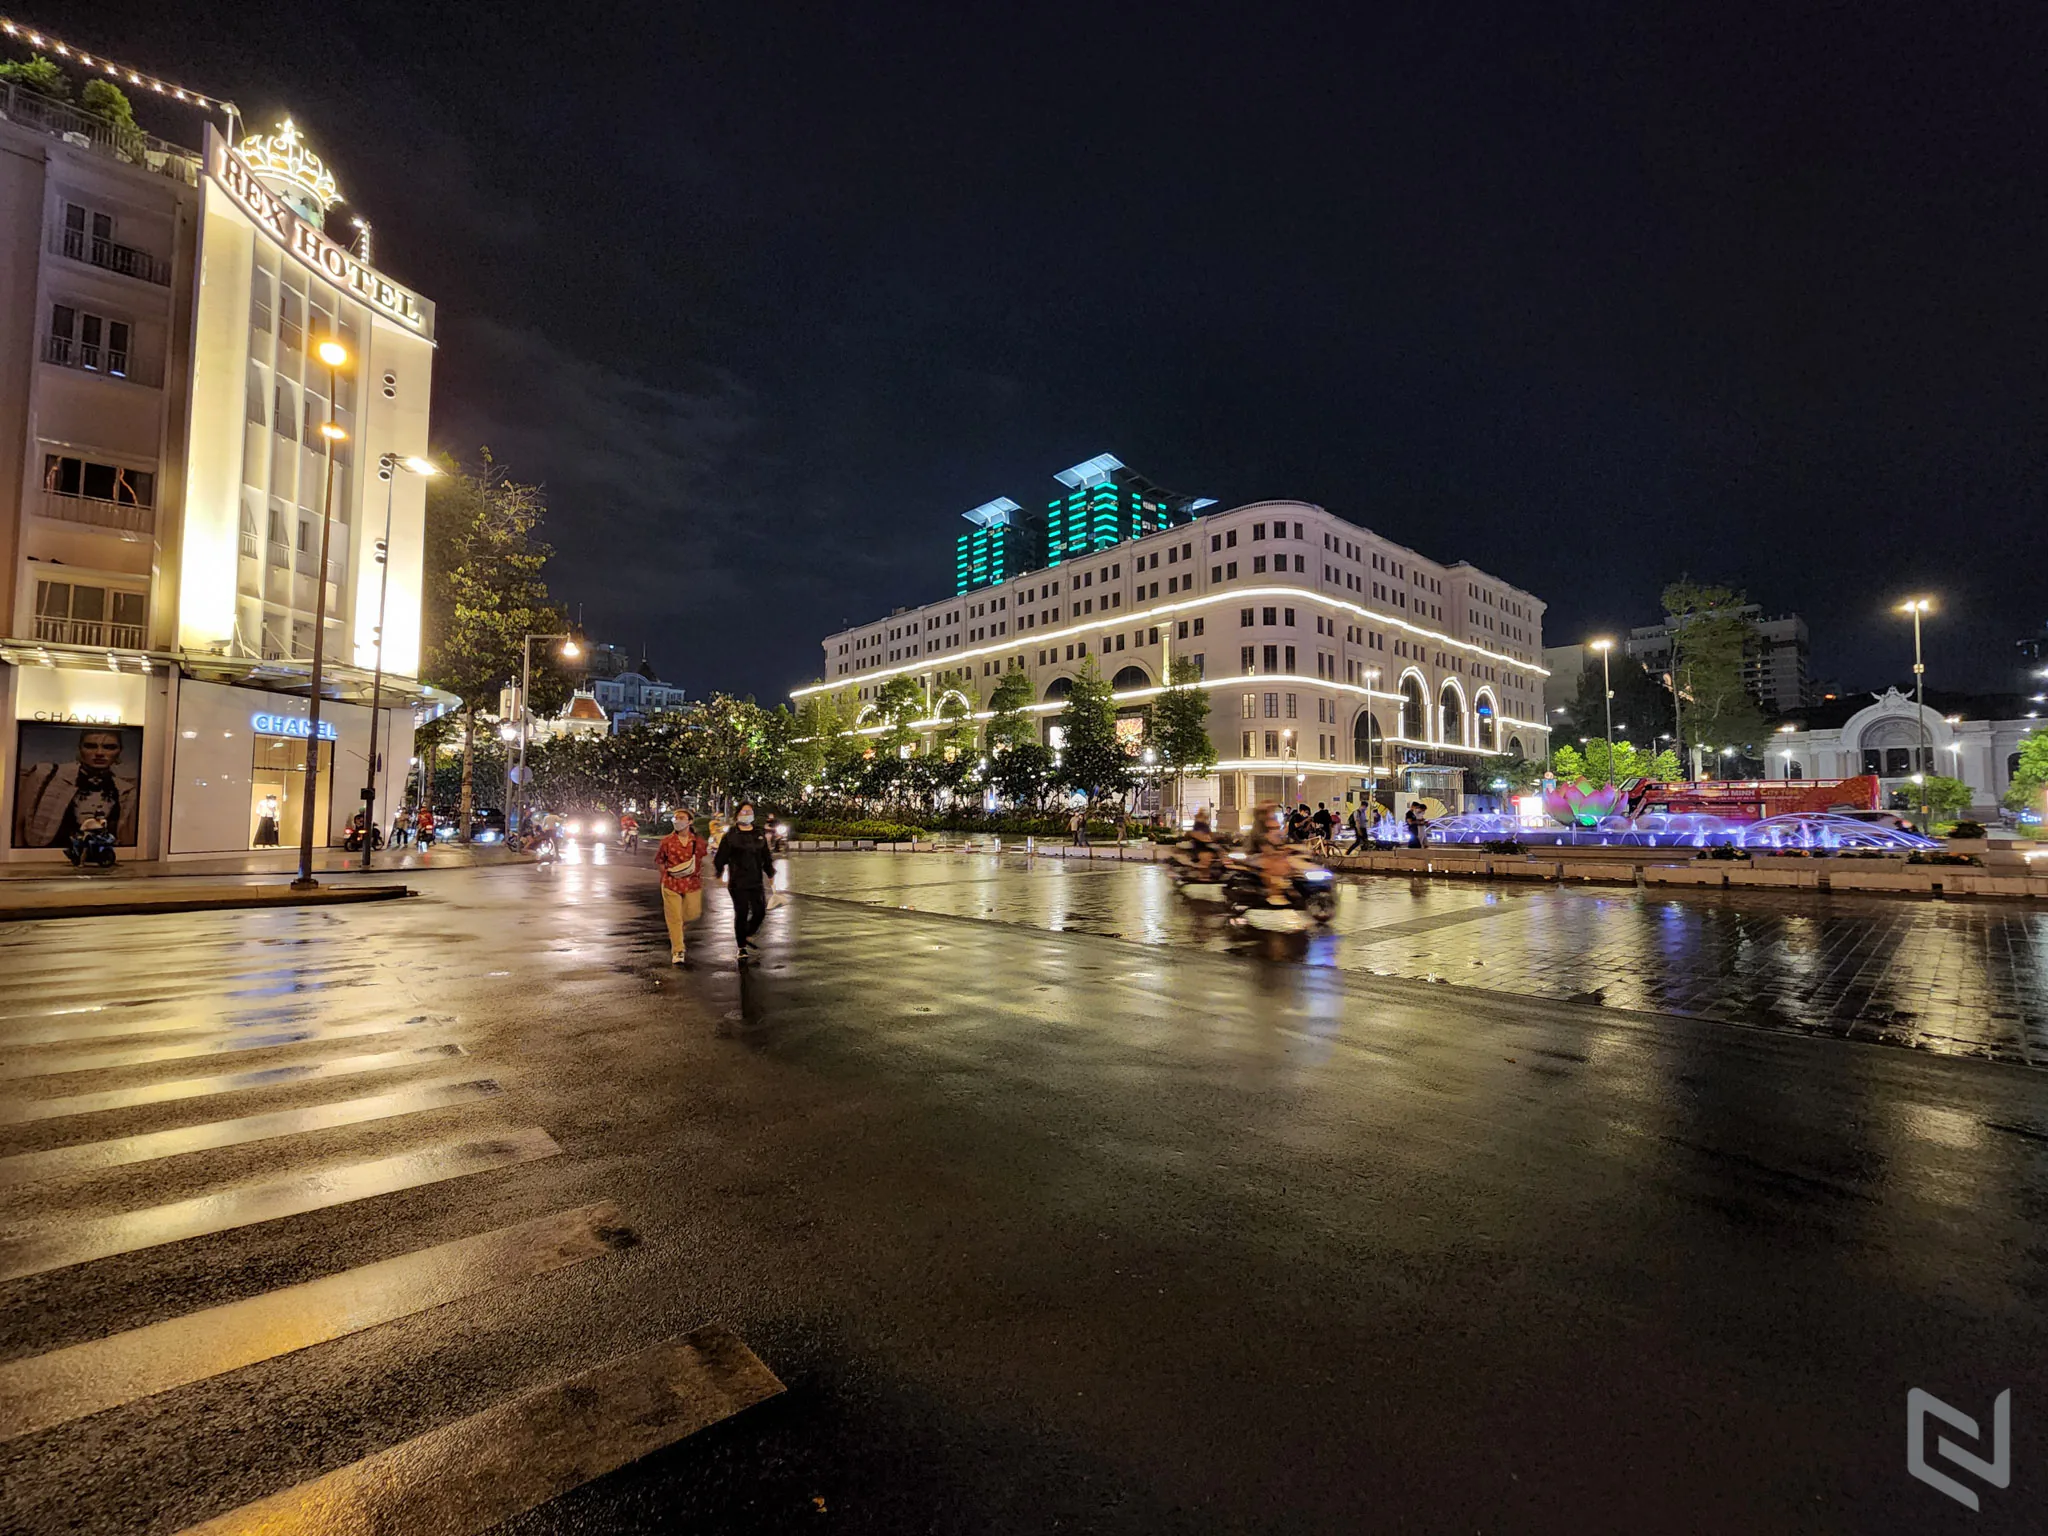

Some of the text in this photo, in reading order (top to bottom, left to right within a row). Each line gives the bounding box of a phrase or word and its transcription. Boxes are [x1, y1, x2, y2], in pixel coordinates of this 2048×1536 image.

[218, 149, 421, 326] REX HOTEL
[34, 711, 127, 726] CHANEL
